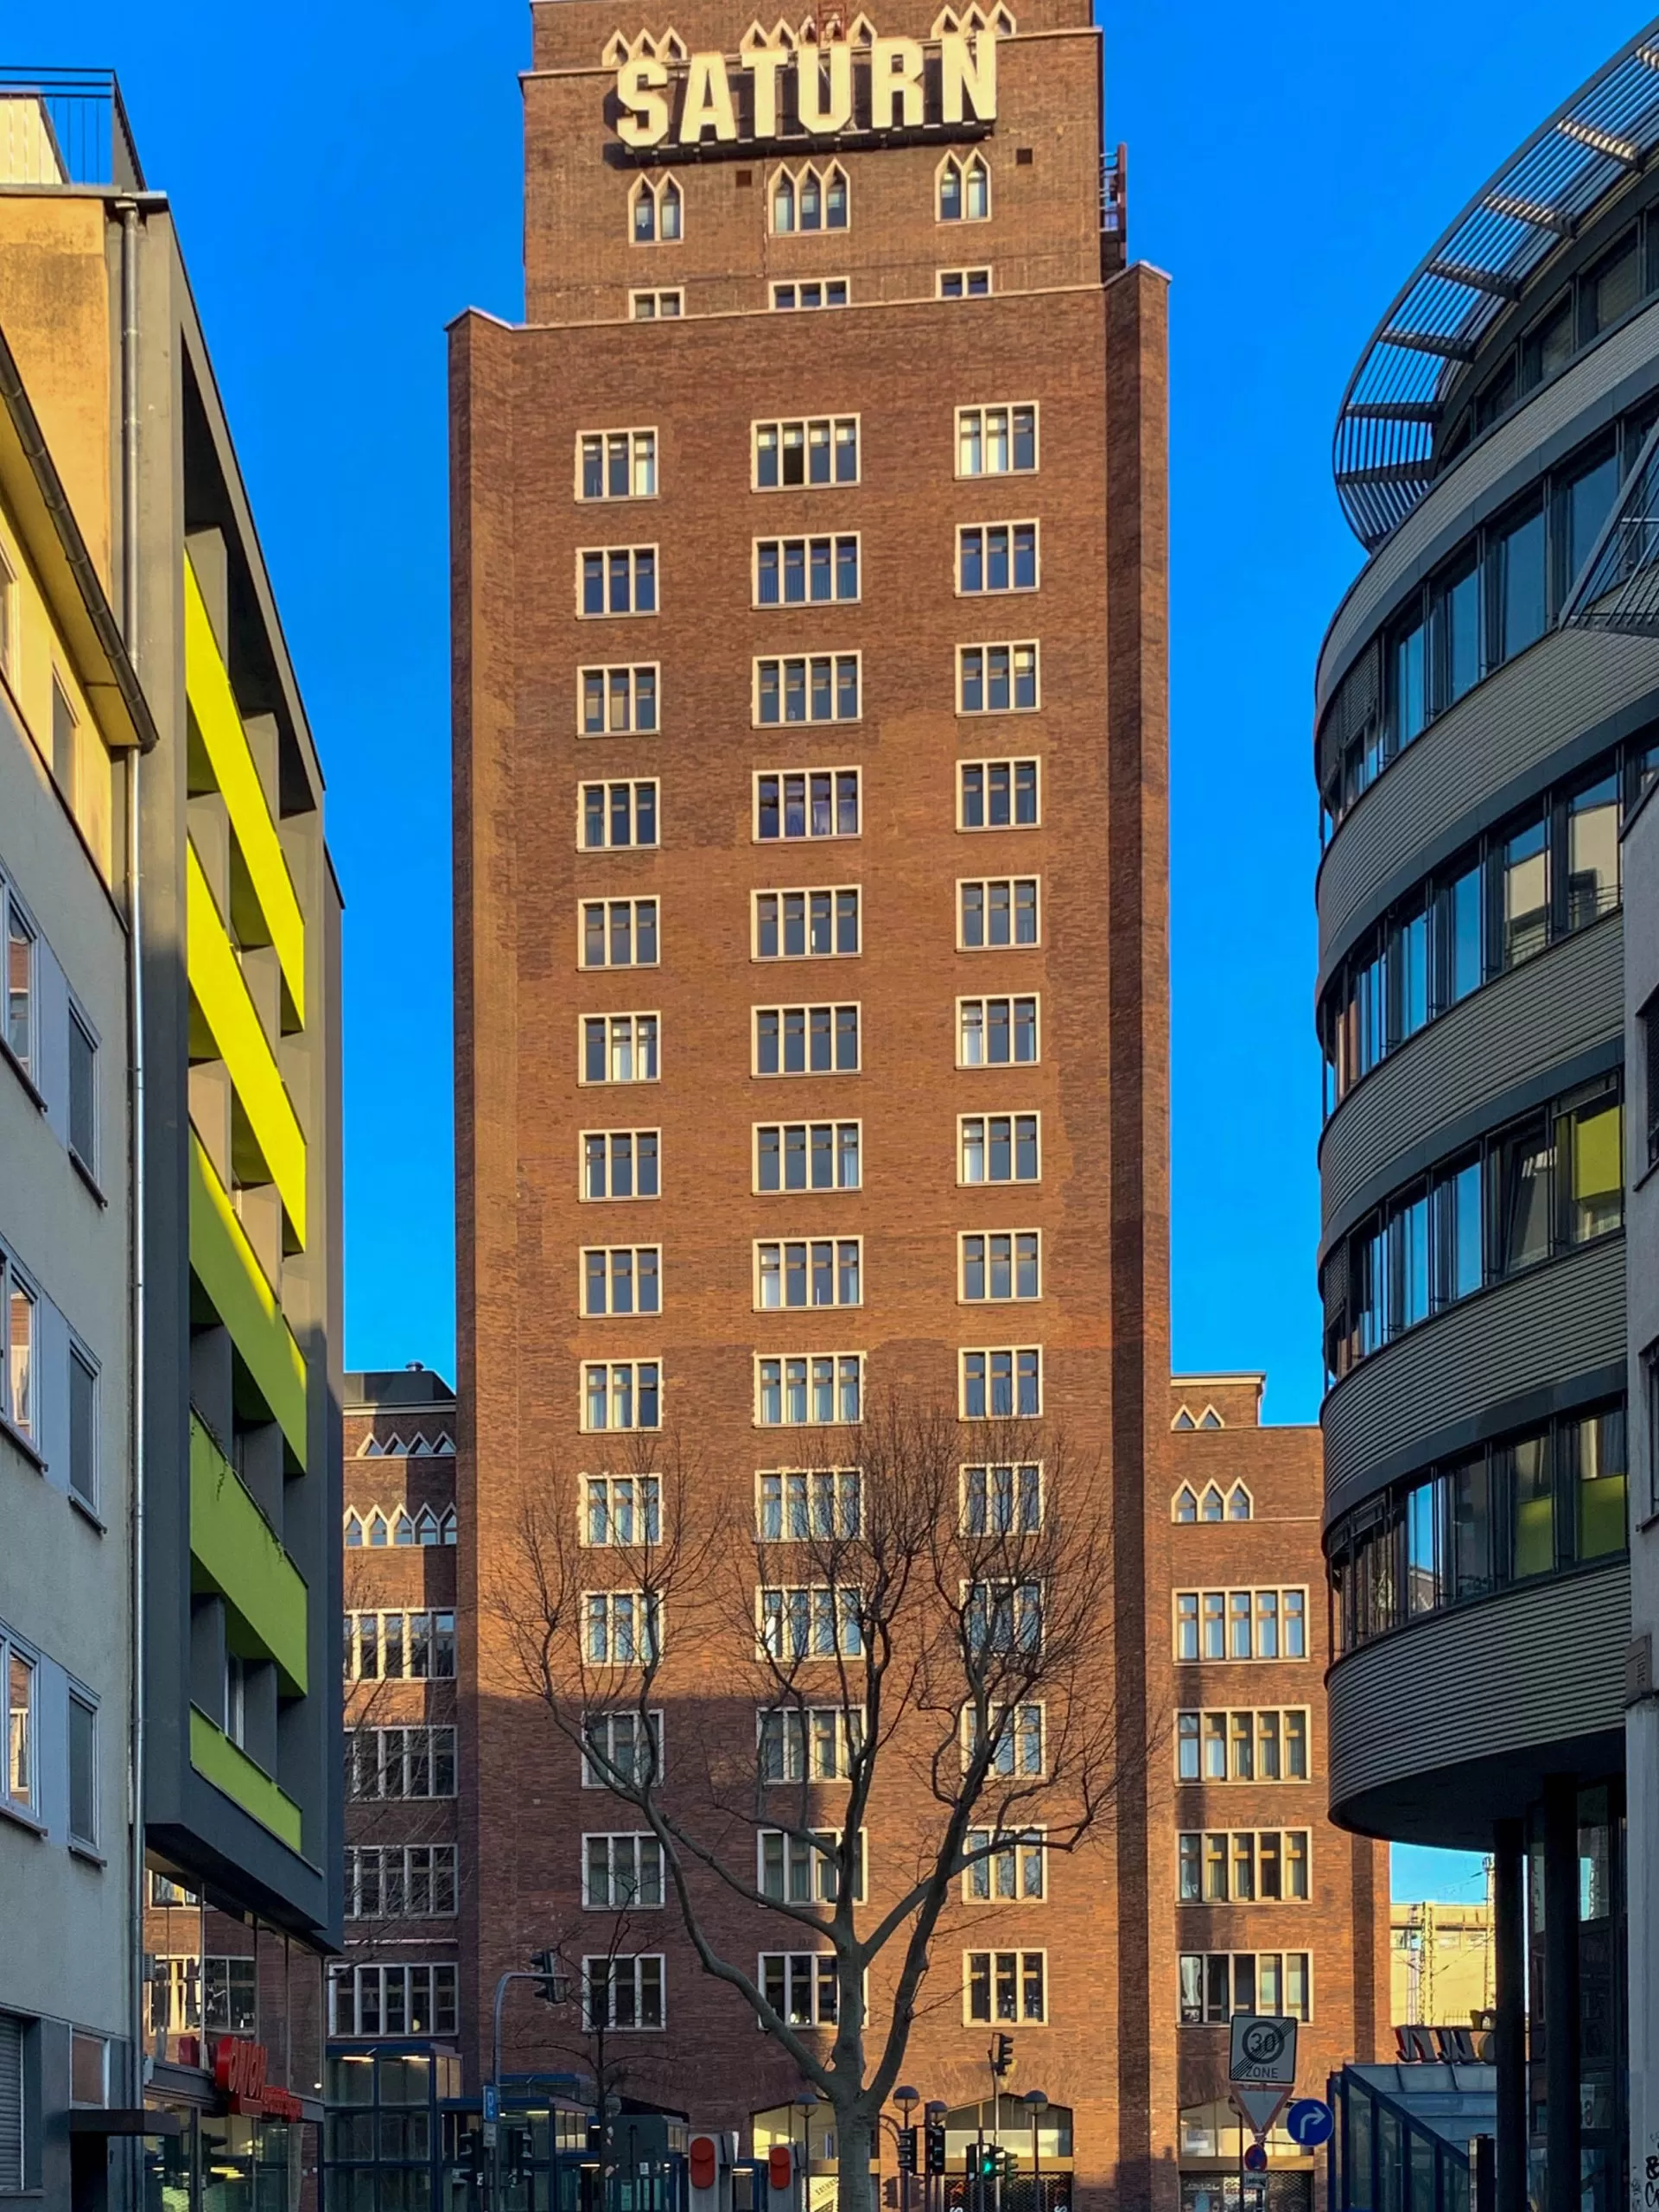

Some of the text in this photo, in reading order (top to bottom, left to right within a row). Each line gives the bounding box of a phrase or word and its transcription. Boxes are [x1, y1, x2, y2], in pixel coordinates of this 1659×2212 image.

[617, 31, 996, 147] SATURN
[1250, 2032, 1276, 2053] 30
[1245, 2066, 1279, 2079] ZONE
